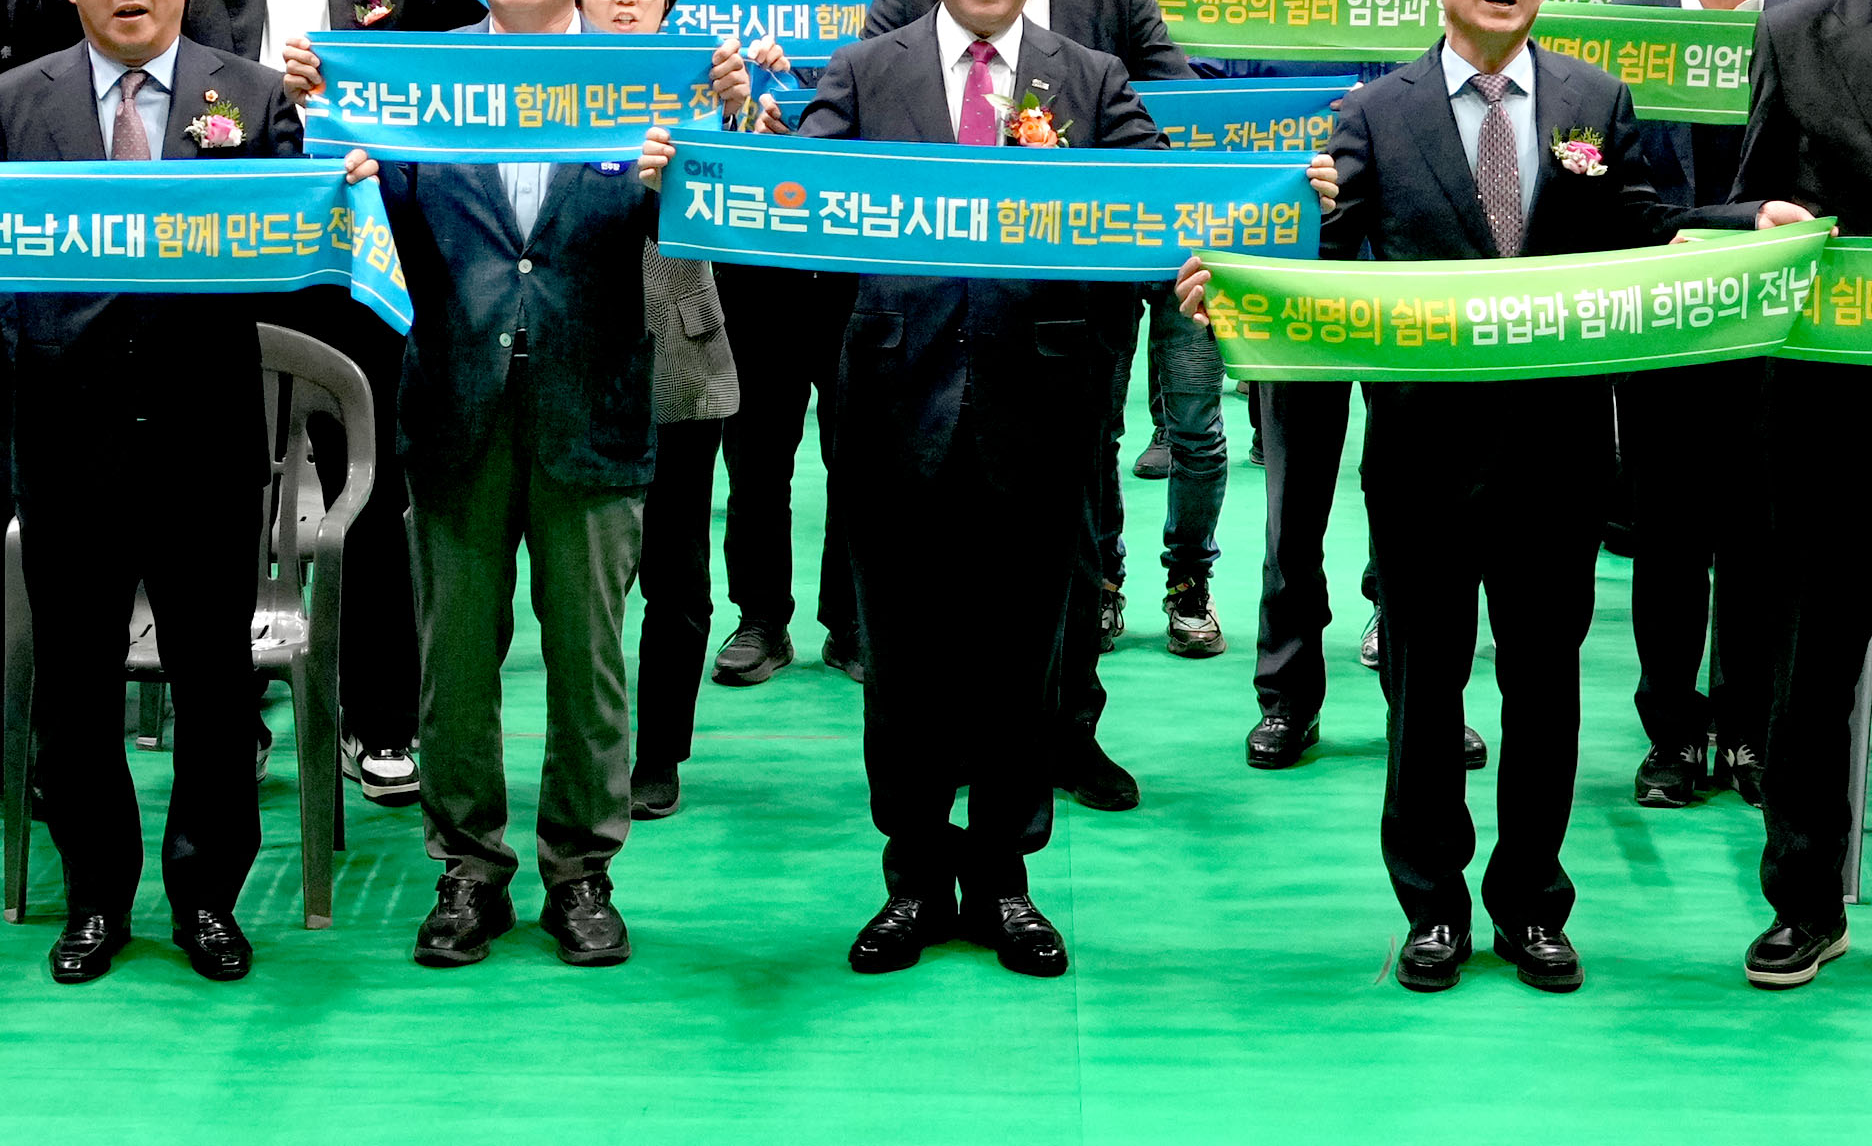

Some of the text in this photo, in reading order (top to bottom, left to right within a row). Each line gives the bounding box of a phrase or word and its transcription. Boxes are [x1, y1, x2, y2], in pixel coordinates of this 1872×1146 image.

[337, 80, 682, 128] 전남시대 함께 만드는
[684, 158, 724, 178] OK!
[154, 212, 219, 259] 함께
[226, 212, 323, 258] 만드는
[685, 180, 1301, 248] 지금은 전남시대 함께 만드는 전남임업
[1209, 275, 1748, 348] 숲은 생명의 쉼터 임업과 함께 희망의
